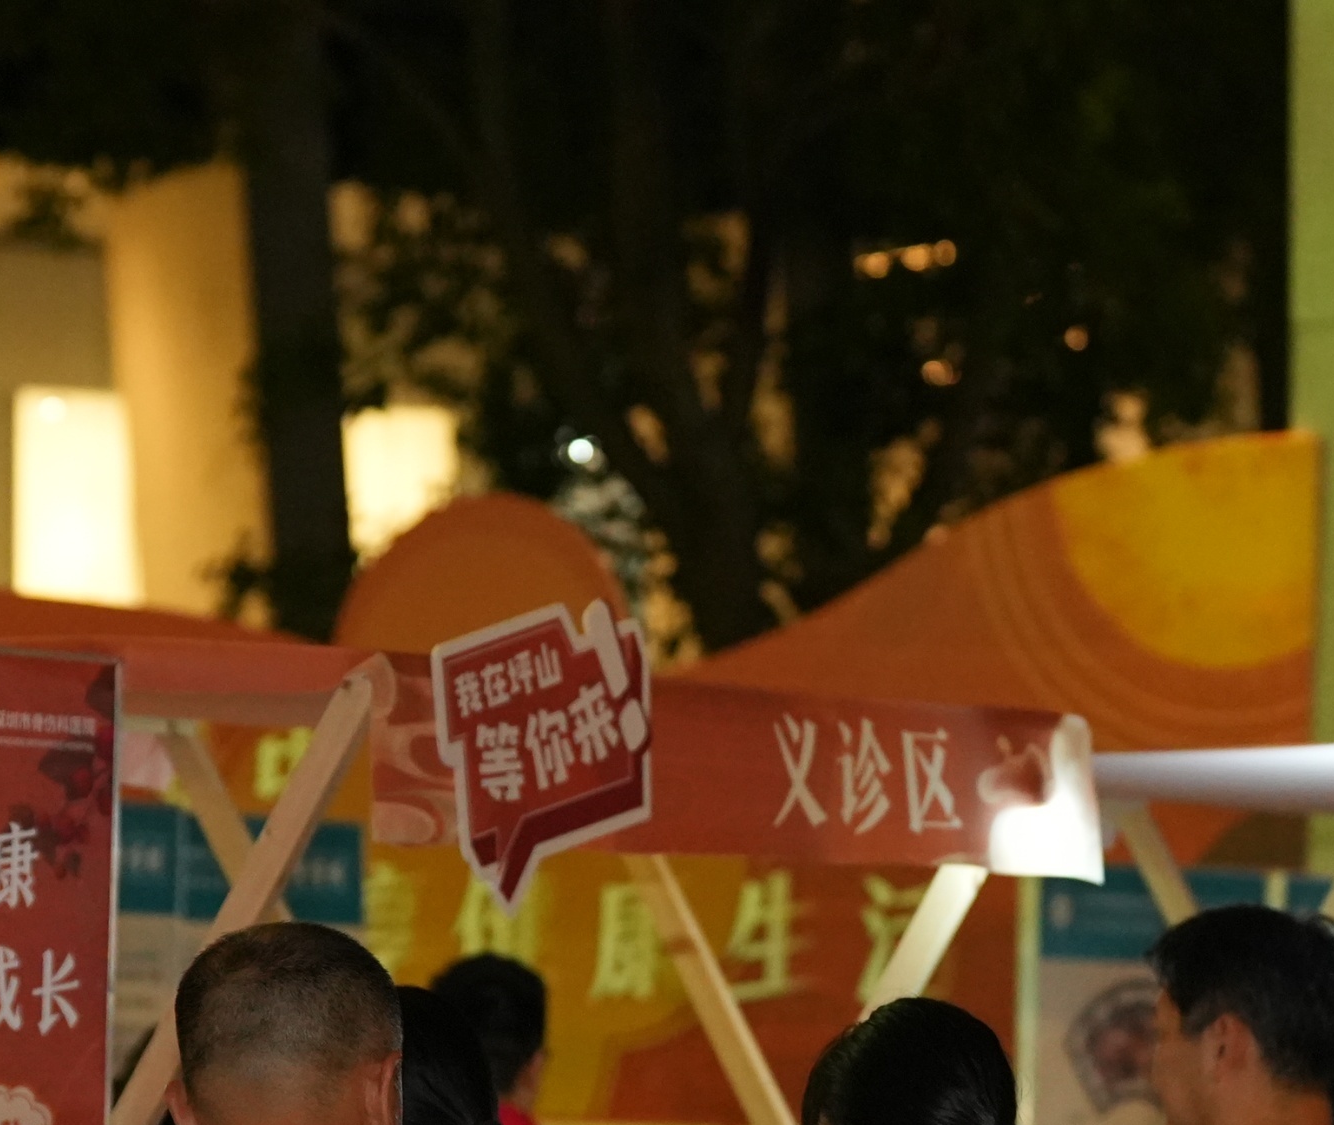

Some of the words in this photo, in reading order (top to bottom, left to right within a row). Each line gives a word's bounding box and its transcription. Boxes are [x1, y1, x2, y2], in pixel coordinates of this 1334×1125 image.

[454, 642, 564, 718] 我在坪山
[772, 711, 964, 836] 义诊区
